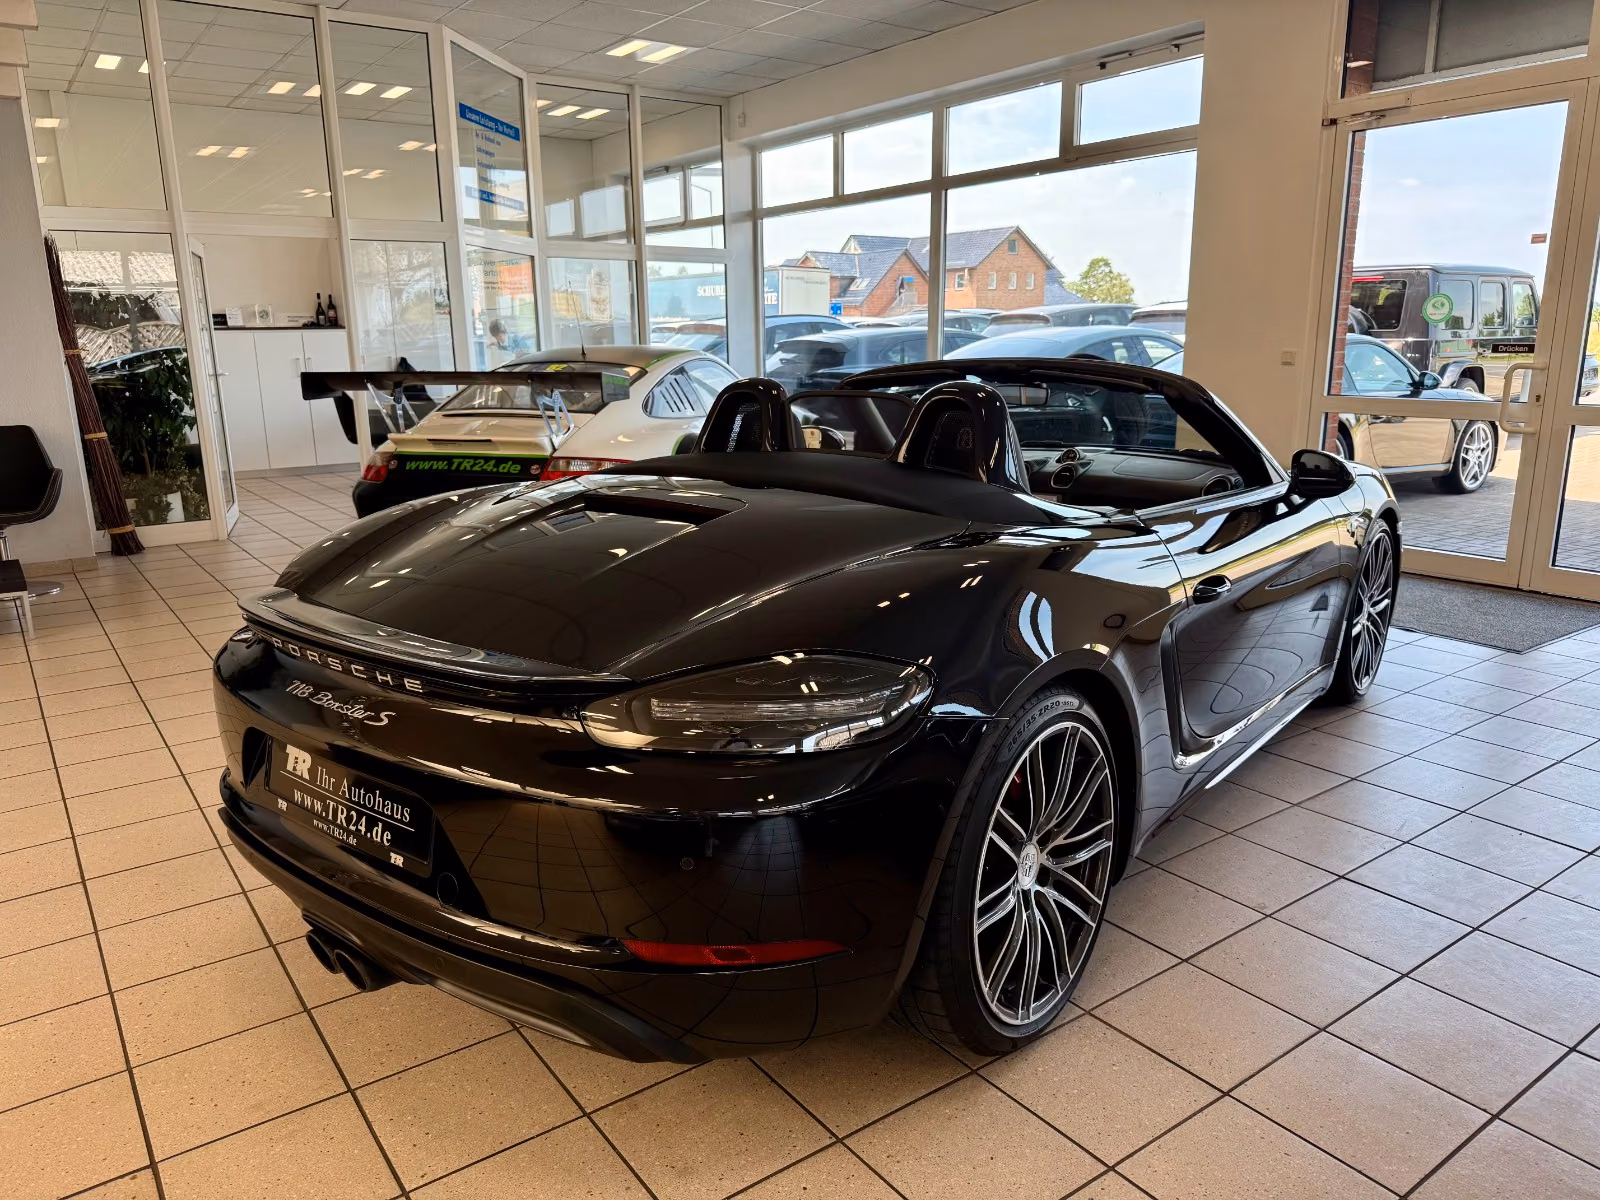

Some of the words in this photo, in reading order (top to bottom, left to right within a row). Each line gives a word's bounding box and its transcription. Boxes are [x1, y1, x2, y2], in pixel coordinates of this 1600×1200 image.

[1498, 344, 1529, 352] Drücken
[405, 458, 521, 474] www.TR24.de
[272, 637, 423, 692] PORSCHE
[285, 679, 314, 697] 718
[309, 691, 376, 719] Boxster
[363, 711, 397, 726] S
[293, 788, 392, 846] www.TR24.de
[316, 766, 336, 791] Ihr
[339, 777, 411, 823] Autohaus
[313, 819, 357, 846] www.TR24.de
